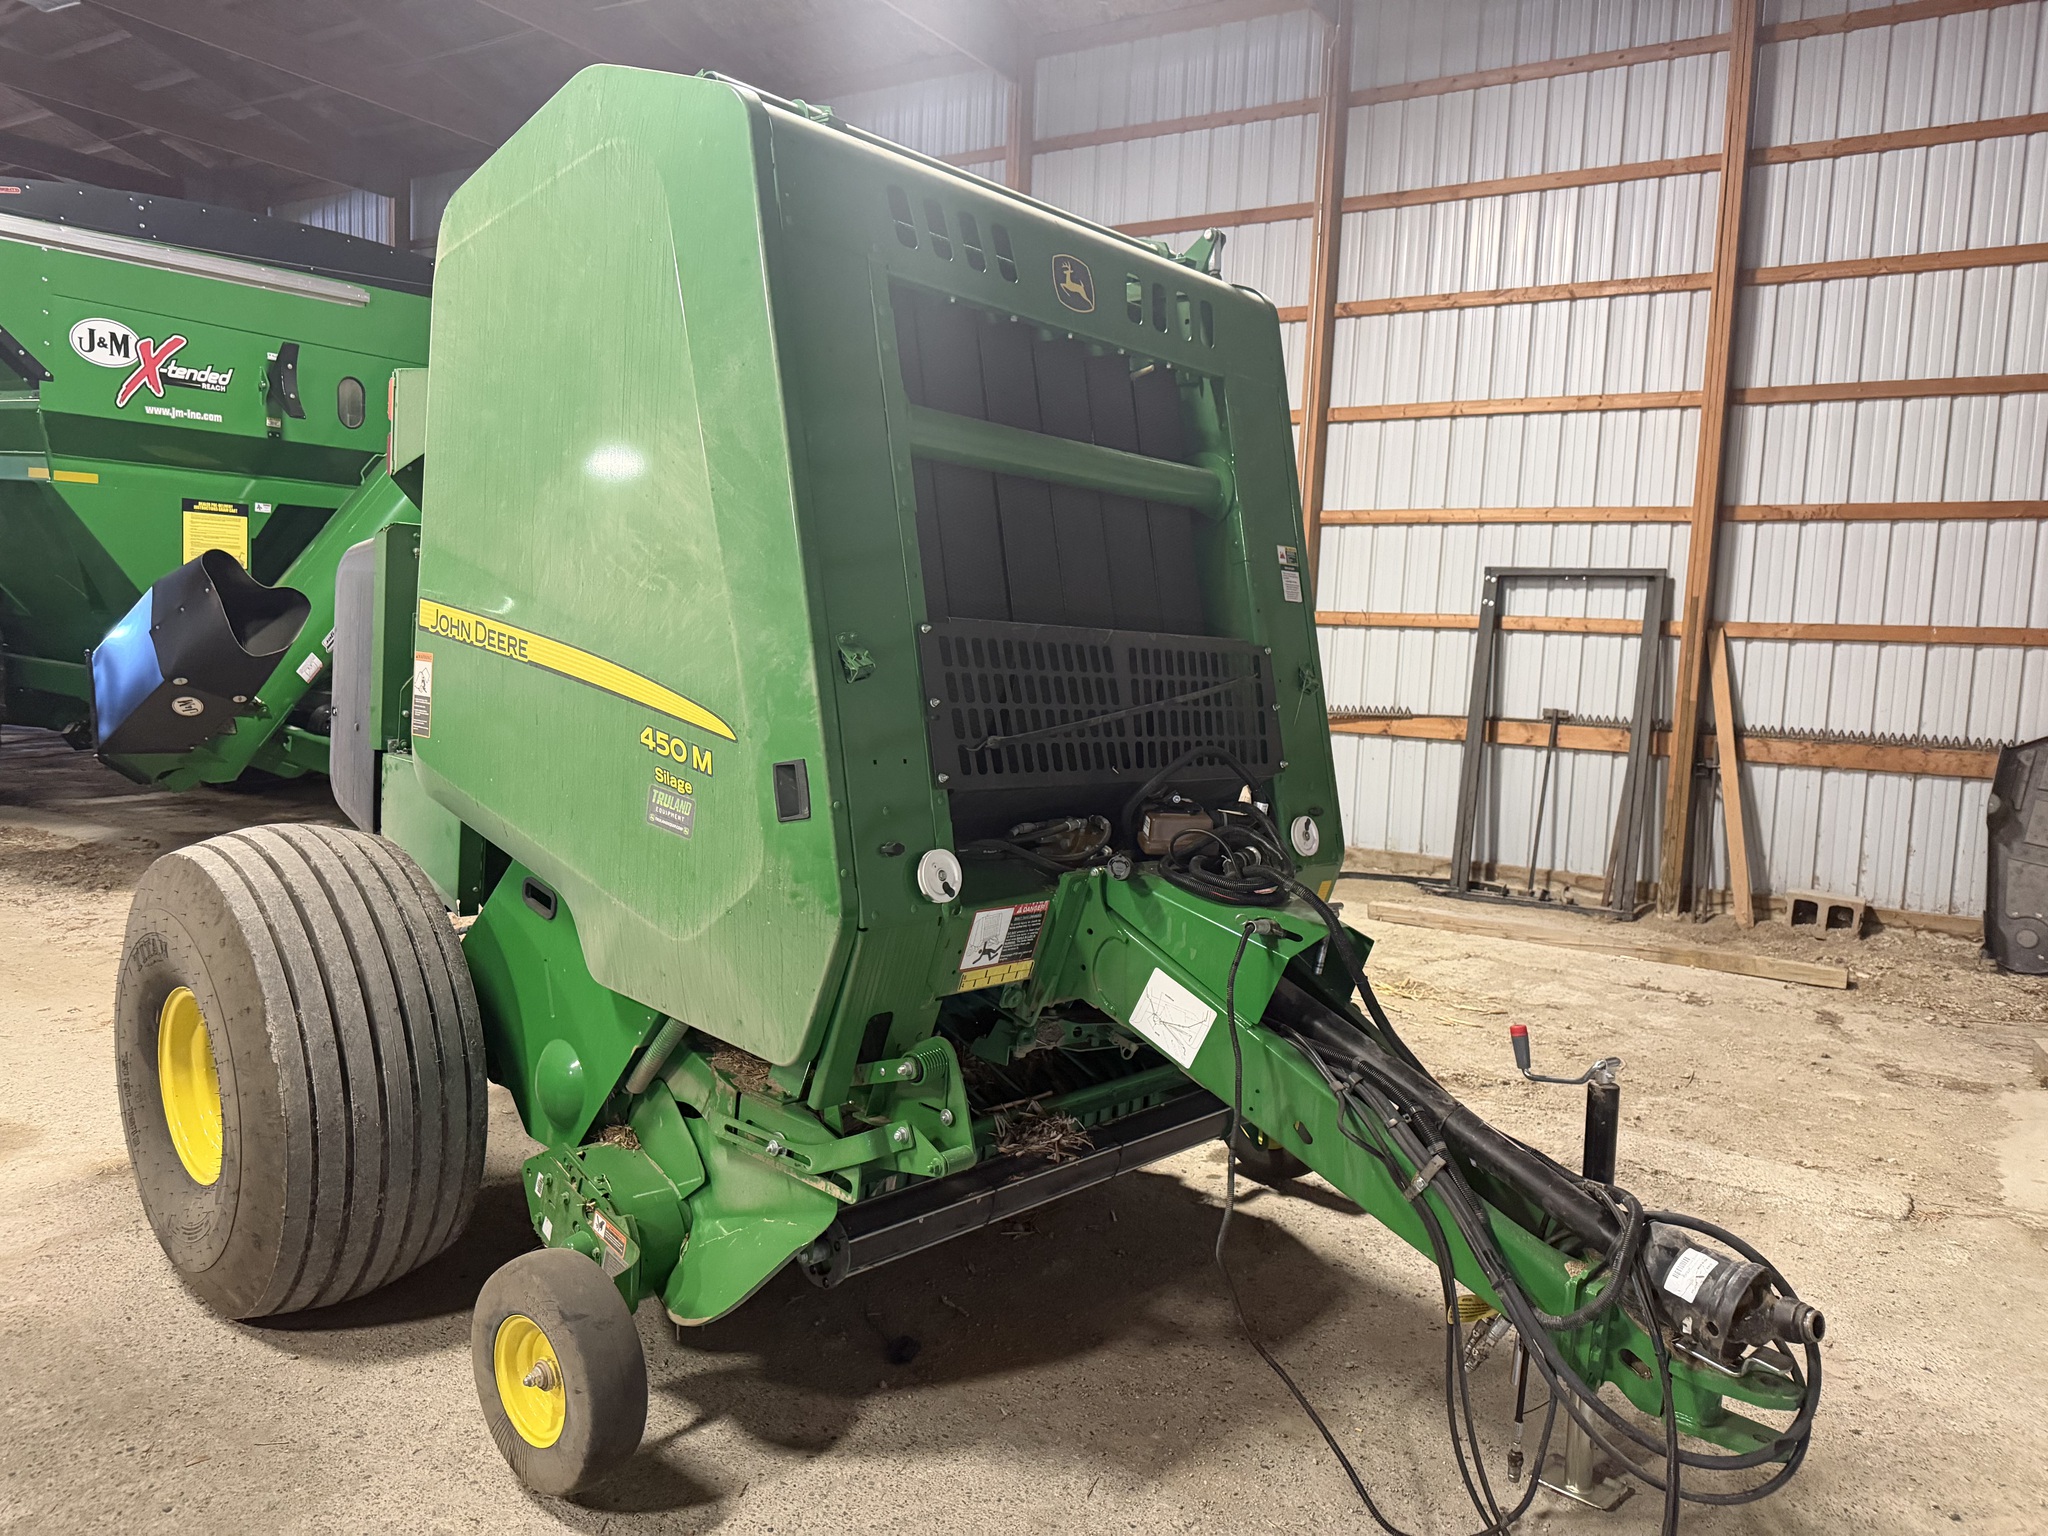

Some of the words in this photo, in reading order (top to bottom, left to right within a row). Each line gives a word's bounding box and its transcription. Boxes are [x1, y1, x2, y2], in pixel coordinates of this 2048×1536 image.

[78, 327, 132, 359] J&M
[201, 383, 226, 393] REACH
[144, 405, 223, 423] www.jm-inc.com
[430, 608, 472, 641] JOHN
[475, 620, 529, 660] DEERE
[640, 725, 688, 764] 450
[692, 743, 713, 777] M
[653, 766, 694, 795] Silage
[651, 788, 692, 816] TRULAND
[655, 806, 685, 822] EQUIPMENT
